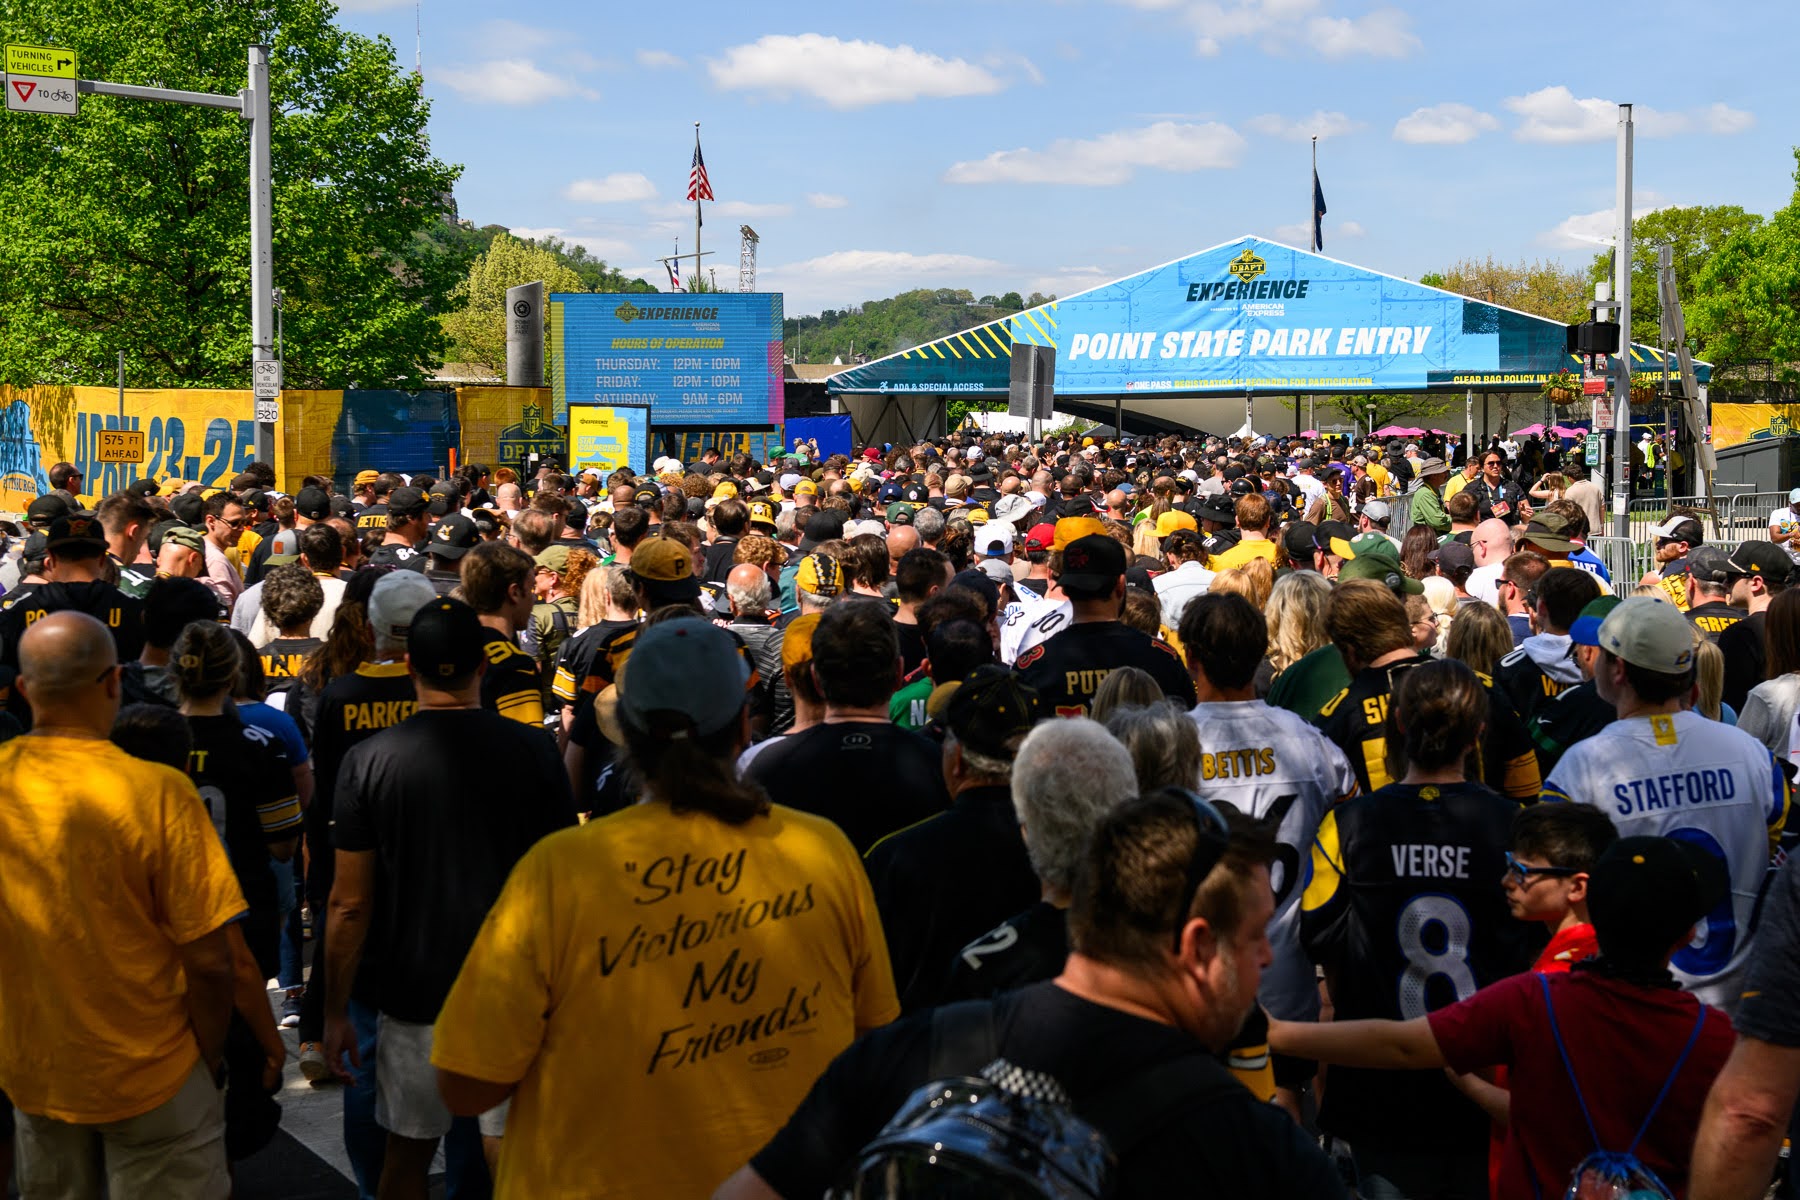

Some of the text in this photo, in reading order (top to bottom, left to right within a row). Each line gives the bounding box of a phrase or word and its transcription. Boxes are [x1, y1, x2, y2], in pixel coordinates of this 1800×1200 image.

[11, 49, 52, 61] TURNING
[10, 61, 54, 73] VEHICLES
[38, 89, 50, 98] TO
[1232, 264, 1263, 272] DRAFT
[1186, 279, 1310, 302] EXPERIENCE
[638, 307, 719, 320] EXPERIENCE
[611, 338, 725, 349] HOURS OF OPERATION
[1068, 325, 1432, 361] POINT STATE PARK ENTRY
[595, 358, 661, 370] THURSDAY:
[673, 358, 702, 370] 12PM
[711, 358, 741, 370] 10PM
[596, 375, 642, 388] FRIDAY:
[673, 375, 701, 387] 12PM
[711, 375, 740, 387] 10PM
[1453, 375, 1481, 384] CLEAR
[1483, 375, 1502, 383] BAG
[1503, 374, 1535, 383] POLICY
[1537, 374, 1547, 383] IN
[1637, 371, 1663, 381] TAFF
[893, 382, 984, 392] ADA & SPECIAL ACCESS
[1174, 379, 1233, 388] REGISTRATION
[1245, 378, 1288, 386] REQUIRED
[1289, 378, 1306, 386] FOR
[1307, 377, 1373, 386] PARTICIPATION
[594, 393, 659, 405] SATURDAY:
[682, 393, 708, 405] 9AM
[718, 393, 743, 405] 6PM
[258, 411, 278, 419] 520
[524, 418, 540, 431] NFL
[1772, 424, 1787, 434] NFL
[104, 435, 124, 445] 575
[104, 450, 139, 459] AHEAD
[3, 477, 36, 493] PITTSBURGH
[357, 515, 388, 528] BETTIS
[675, 559, 685, 575] P
[1202, 747, 1275, 780] BETTIS
[1614, 768, 1736, 815] STAFFORD
[1391, 844, 1472, 879] VERSE
[598, 883, 814, 977] Victorious
[1397, 893, 1478, 1022] 8
[682, 948, 763, 1008] My
